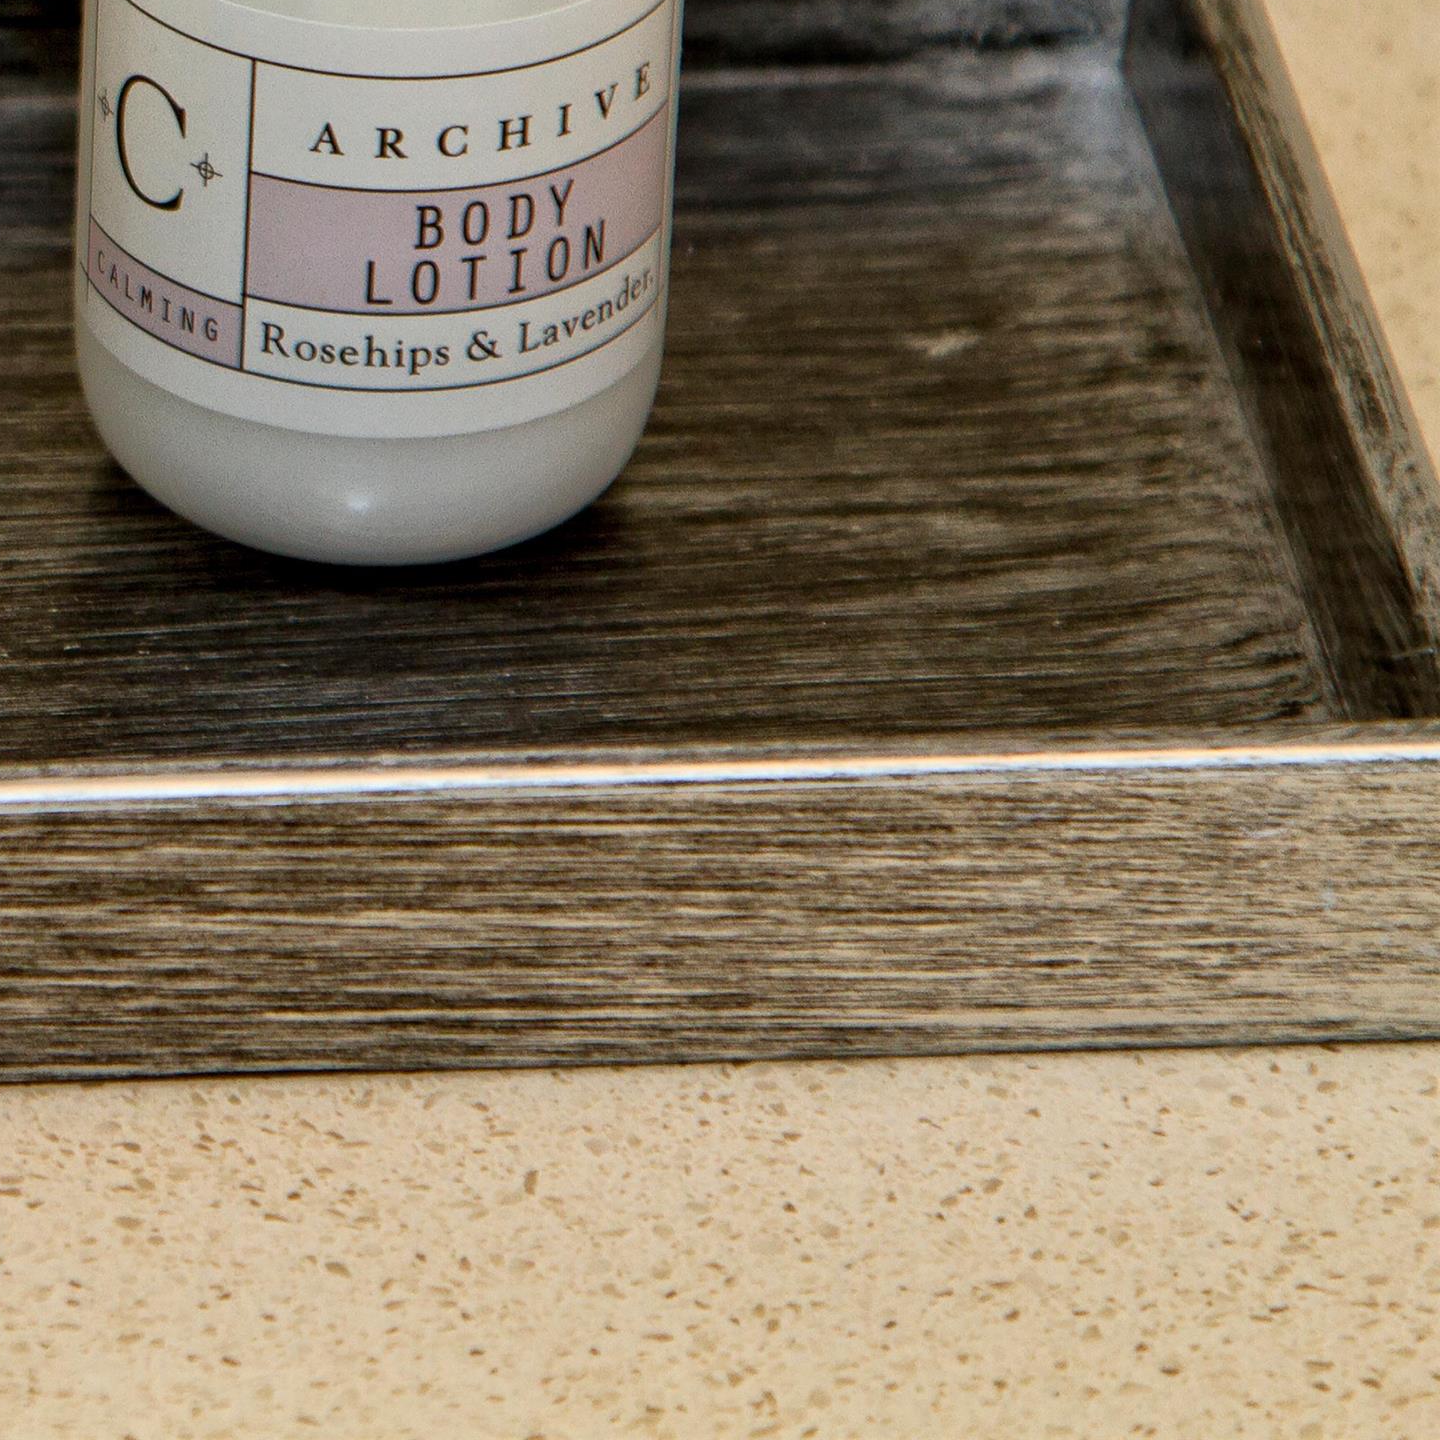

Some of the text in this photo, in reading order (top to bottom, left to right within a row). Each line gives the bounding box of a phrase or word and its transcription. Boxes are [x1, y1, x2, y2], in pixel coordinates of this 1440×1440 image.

[117, 75, 186, 211] C
[310, 61, 652, 158] ARCHIVE
[415, 179, 574, 250] BODY
[97, 250, 219, 342] CALMING
[366, 219, 608, 305] LOTION
[260, 322, 451, 375] Rosehips
[465, 332, 502, 360] &
